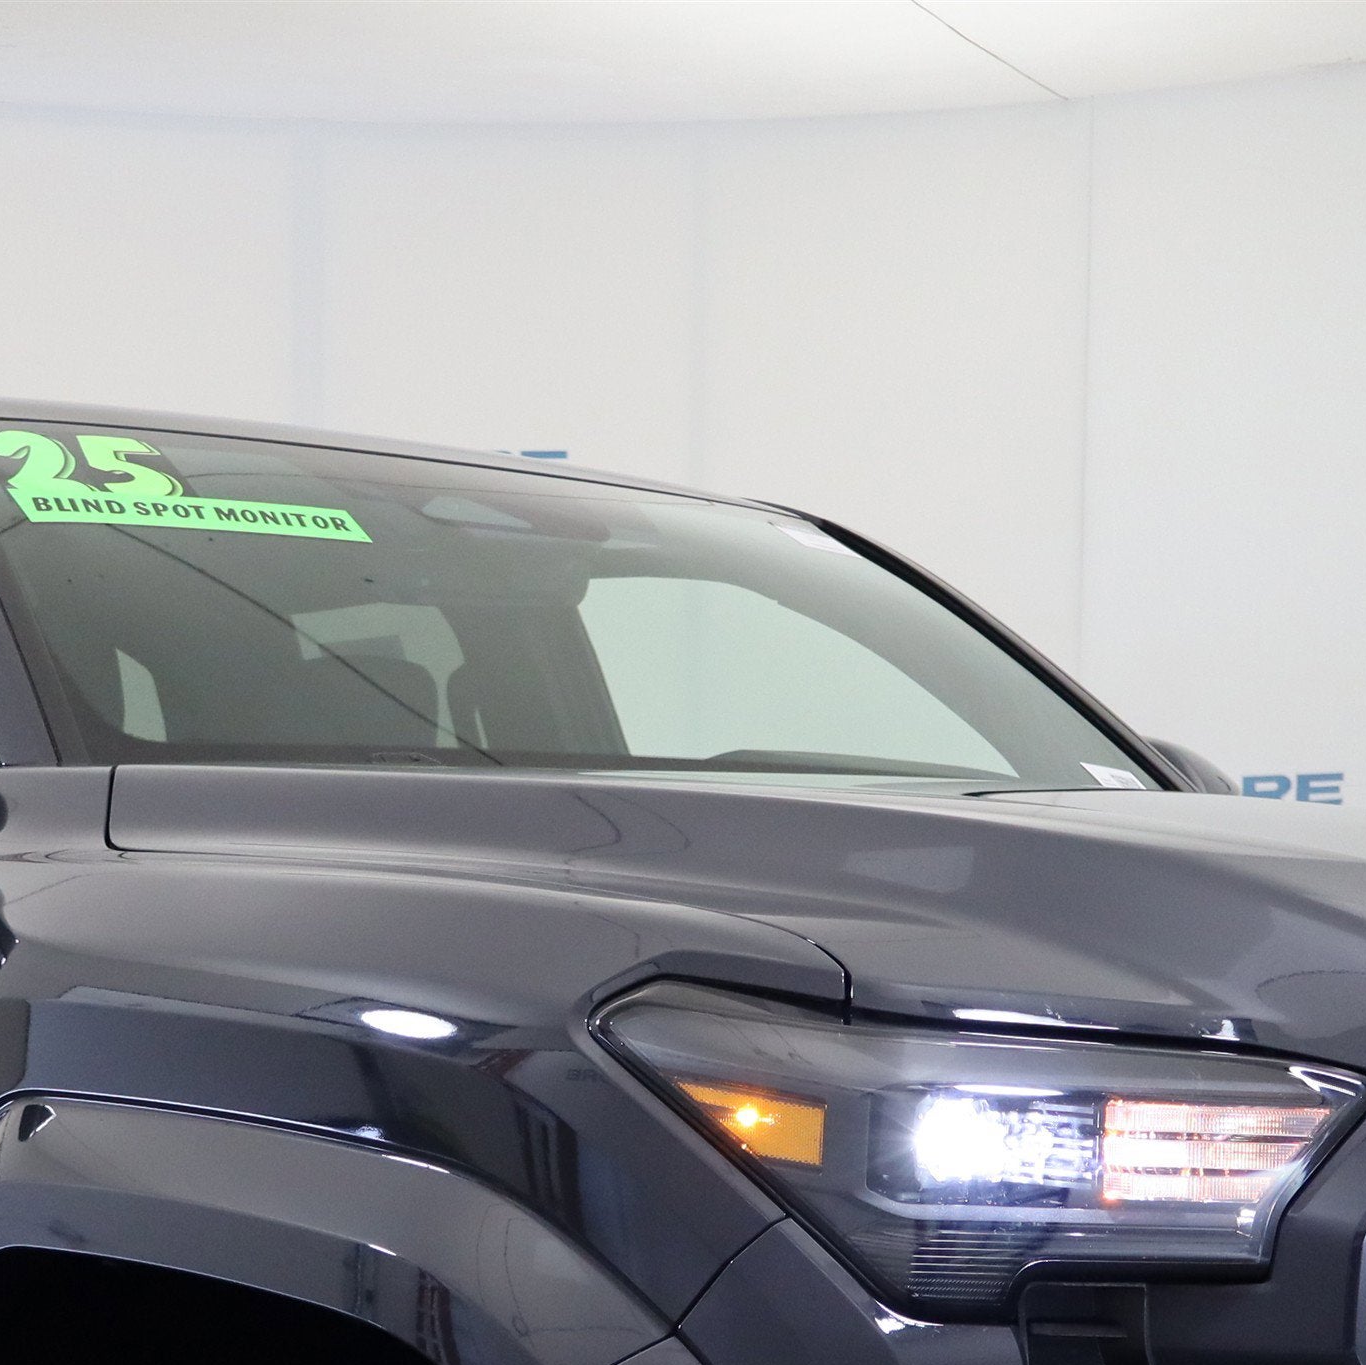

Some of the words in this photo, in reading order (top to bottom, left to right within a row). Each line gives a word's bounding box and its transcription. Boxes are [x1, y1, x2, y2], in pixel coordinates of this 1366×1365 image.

[34, 496, 127, 515] BLIND
[135, 500, 206, 520] SPOT
[216, 506, 353, 533] MONITOR
